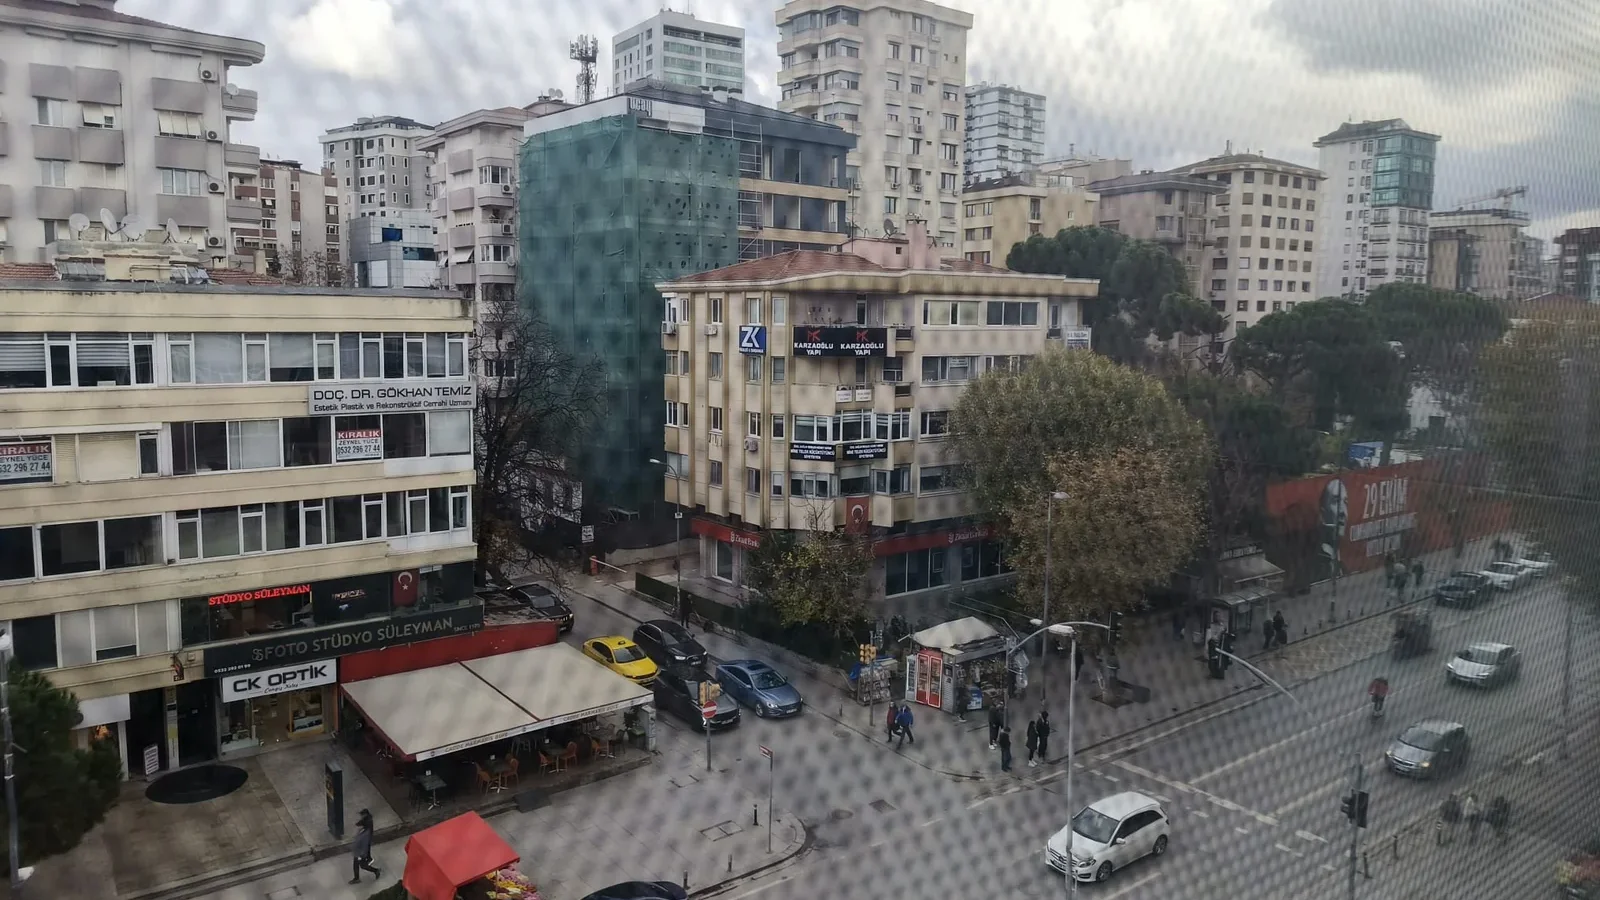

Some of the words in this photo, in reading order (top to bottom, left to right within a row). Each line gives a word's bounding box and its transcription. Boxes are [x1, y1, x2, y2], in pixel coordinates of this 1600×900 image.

[741, 327, 760, 348] ZK
[313, 390, 348, 402] DOÇ.
[351, 388, 374, 399] DR.
[377, 386, 433, 399] GÖKHAN
[434, 384, 472, 397] TEMİZ
[314, 403, 339, 412] Estetik
[340, 402, 364, 411] Plastik
[376, 400, 422, 410] Rekonstrüktif
[423, 399, 448, 408] Cerrahi
[0, 445, 50, 455] İRALIK
[0, 455, 26, 463] EYNEL
[0, 463, 12, 473] 532
[14, 462, 28, 472] 296
[30, 462, 39, 471] 27
[41, 461, 51, 470] 44
[1363, 482, 1378, 519] 29
[208, 592, 253, 606] STÜDYO
[254, 584, 311, 600] SÜLEYMAN
[265, 641, 308, 661] FOTO
[312, 630, 373, 652] STÜDYO
[377, 616, 453, 641] SÜLEYMAN
[233, 676, 261, 693] CK
[267, 664, 328, 687] OPTİK
